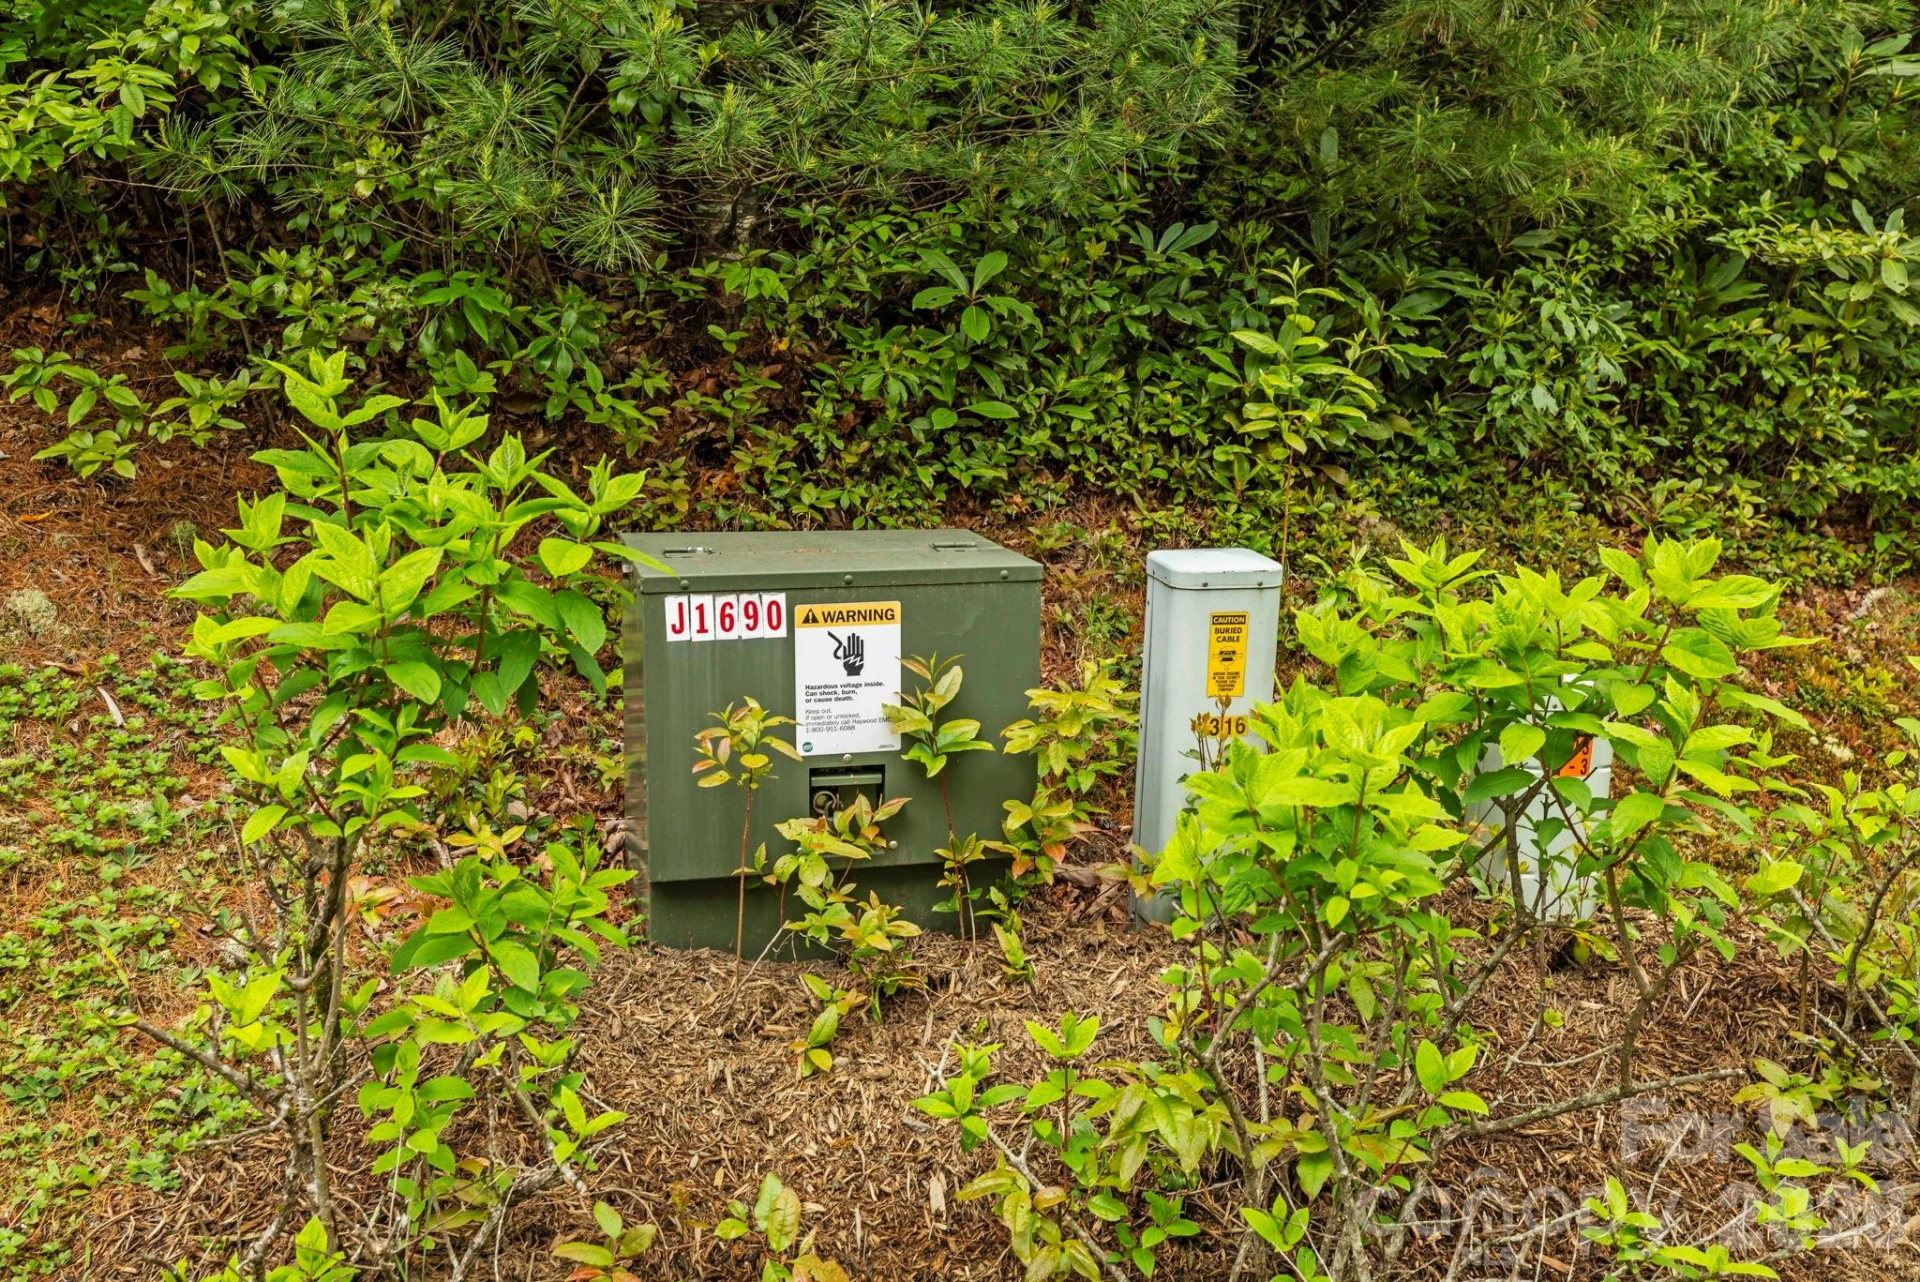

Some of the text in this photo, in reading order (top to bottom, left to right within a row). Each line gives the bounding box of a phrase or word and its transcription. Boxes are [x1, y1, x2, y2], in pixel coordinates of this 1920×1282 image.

[671, 600, 782, 634] J1690
[822, 608, 895, 623] WARNING
[1213, 616, 1245, 624] CAUTION
[1216, 635, 1240, 643] CABLE
